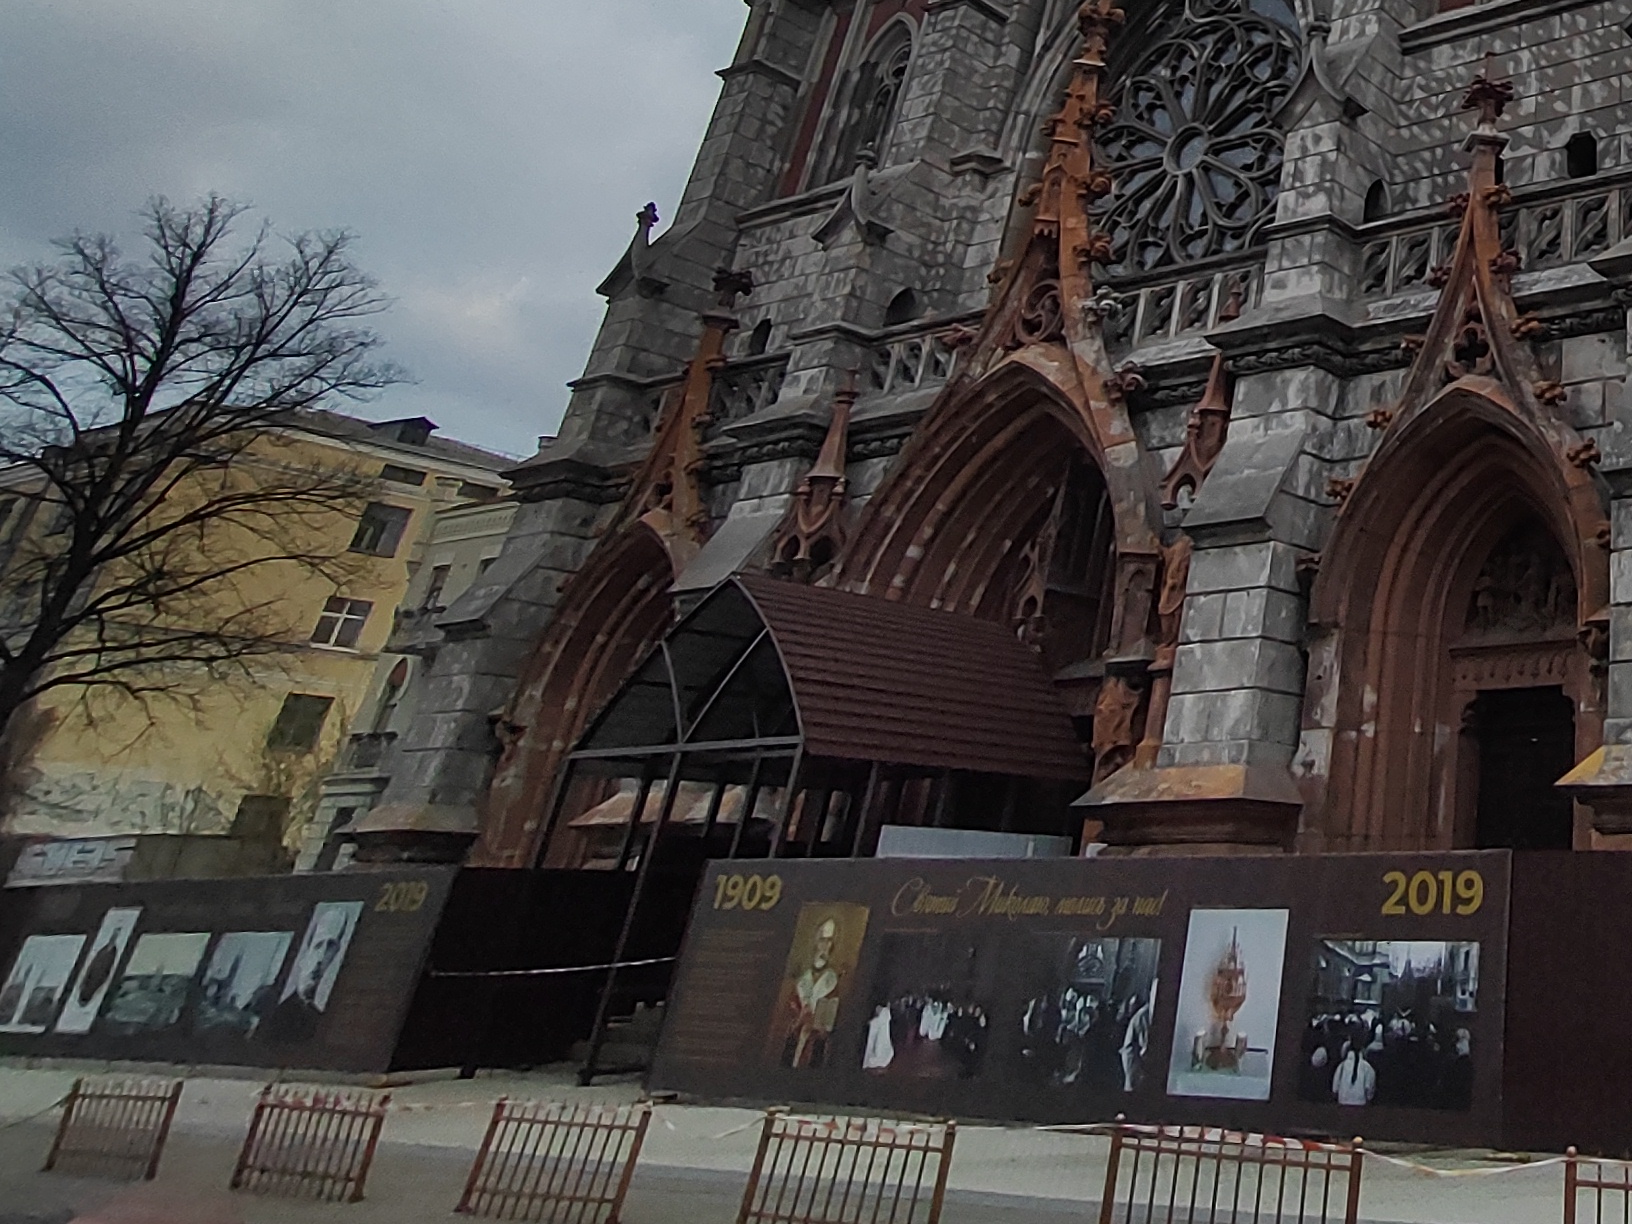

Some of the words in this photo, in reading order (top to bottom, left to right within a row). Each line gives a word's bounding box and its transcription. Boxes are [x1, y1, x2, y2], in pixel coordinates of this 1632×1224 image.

[374, 881, 428, 912] 2019
[713, 874, 783, 911] 1909
[1381, 870, 1484, 915] 2019
[1096, 895, 1129, 930] за
